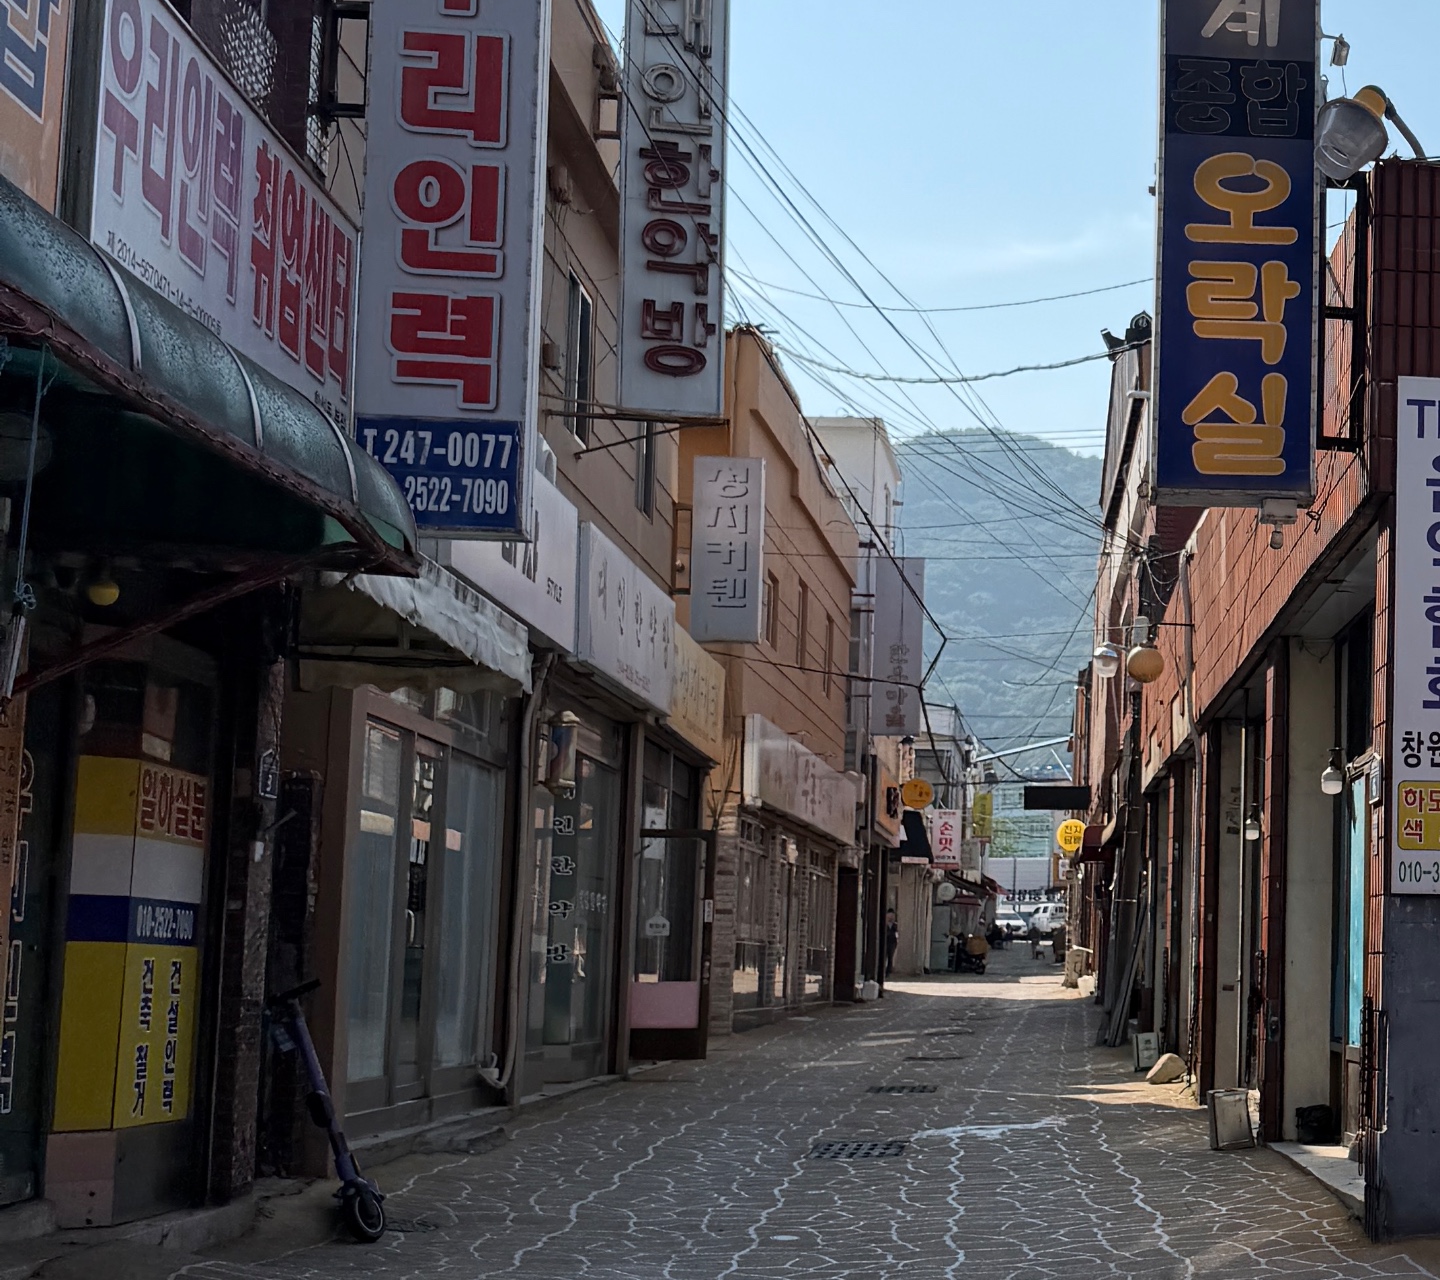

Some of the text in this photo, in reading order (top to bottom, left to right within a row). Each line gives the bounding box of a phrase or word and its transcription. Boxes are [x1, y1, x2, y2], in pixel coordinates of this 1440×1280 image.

[1170, 58, 1308, 137] 종합
[251, 138, 354, 404] 취업센터
[1181, 151, 1301, 477] 오락실
